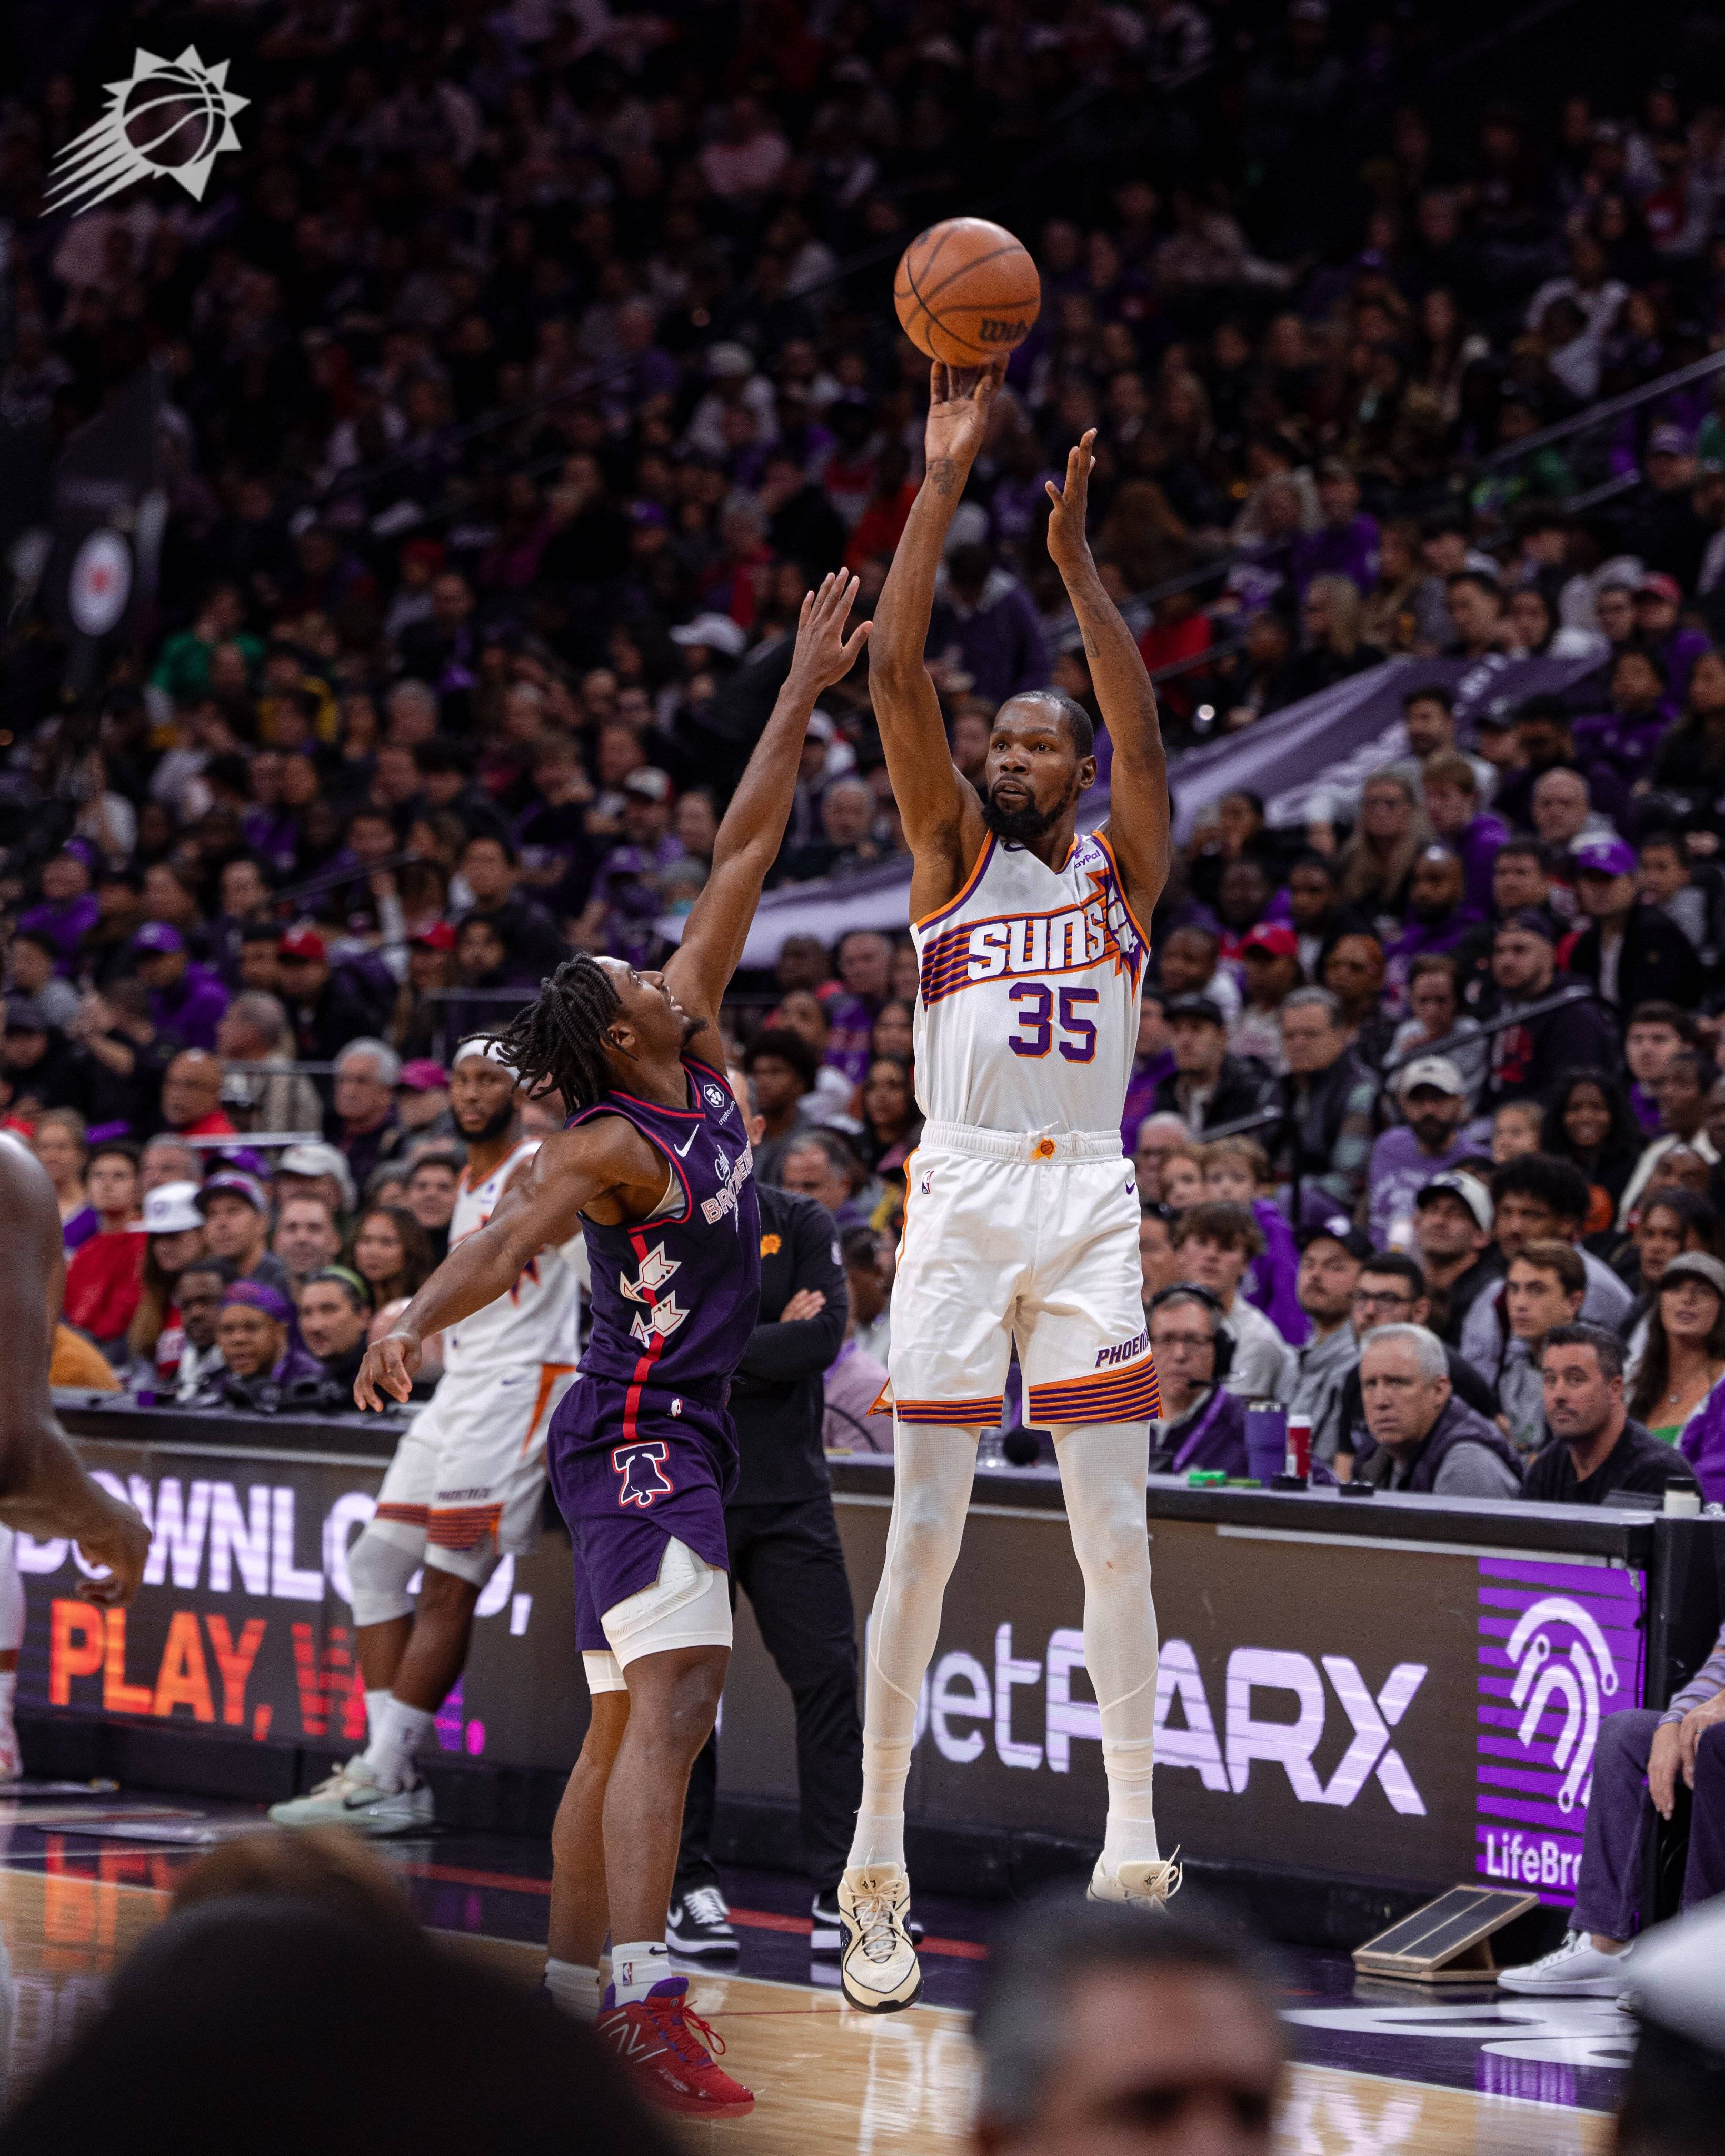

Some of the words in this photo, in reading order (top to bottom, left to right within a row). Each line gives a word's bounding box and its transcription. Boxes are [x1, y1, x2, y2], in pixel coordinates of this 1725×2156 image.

[1074, 850, 1101, 869] ayPal
[967, 902, 1105, 982] SUNS
[1008, 981, 1100, 1064] 35
[49, 1597, 273, 1742] PLAY,
[865, 1613, 1429, 1815] etPARX
